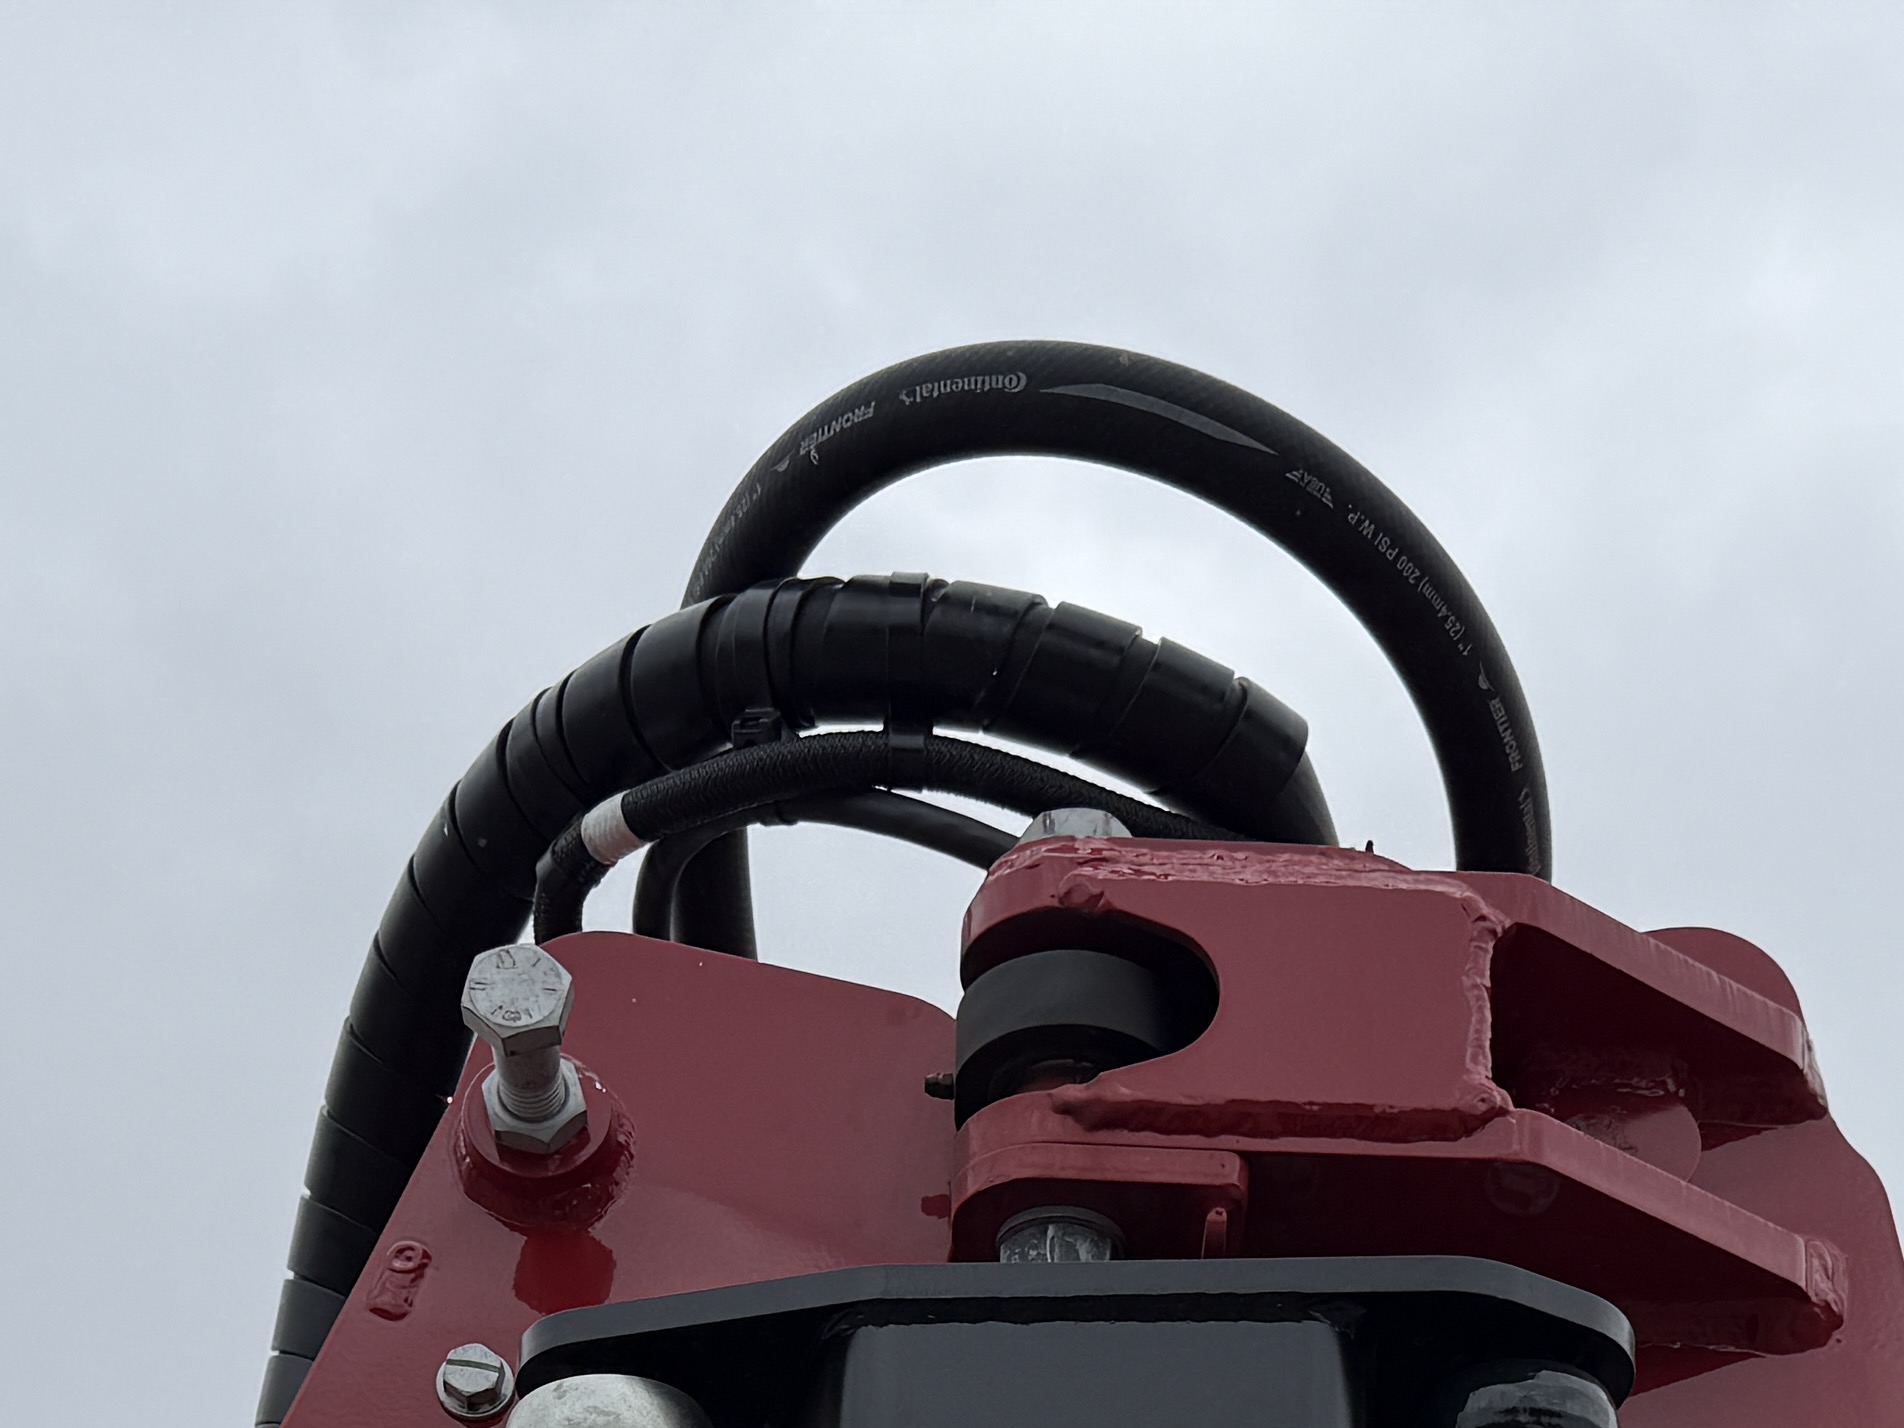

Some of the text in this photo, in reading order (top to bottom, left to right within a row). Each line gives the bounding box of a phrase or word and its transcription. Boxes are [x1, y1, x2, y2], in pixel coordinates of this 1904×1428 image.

[800, 401, 875, 456] FRONTIER
[1374, 533, 1399, 561] PSI
[1396, 555, 1421, 586] 200
[1487, 697, 1524, 773] FRONTIER
